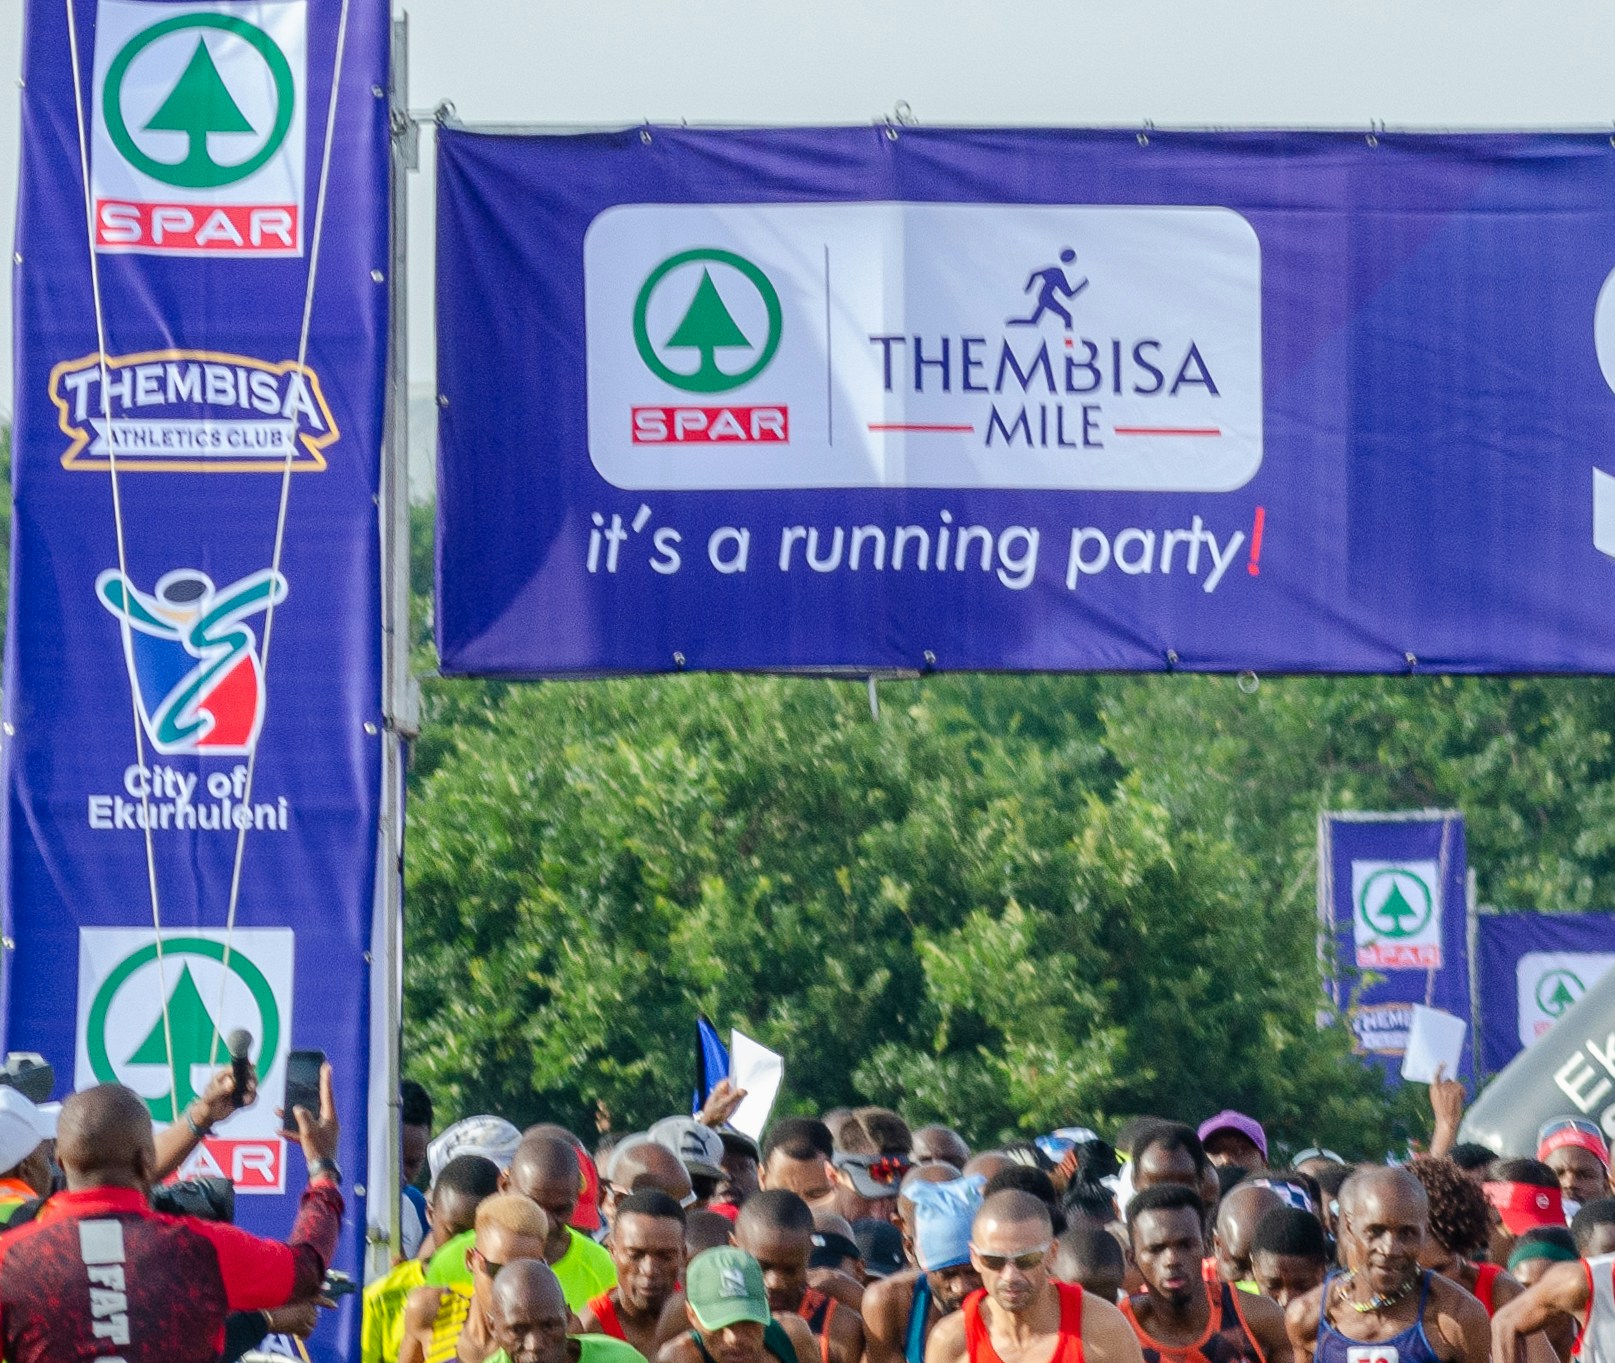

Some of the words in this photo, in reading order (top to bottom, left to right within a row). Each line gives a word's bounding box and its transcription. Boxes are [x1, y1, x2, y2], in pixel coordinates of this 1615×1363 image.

[97, 204, 295, 248] SPAR
[869, 336, 1221, 397] THEMBISA
[64, 362, 324, 430] THEMBISA
[105, 428, 221, 449] ATHLETICS
[226, 428, 284, 448] CLUB
[635, 408, 785, 442] SPAR
[985, 404, 1104, 449] MILE
[587, 503, 682, 574] it's
[707, 525, 750, 574] a
[779, 509, 1041, 589] running
[1066, 506, 1266, 593] party!
[124, 766, 201, 804] City
[205, 763, 253, 797] of
[88, 795, 289, 832] Ekurhuleni
[178, 1143, 280, 1184] AR
[86, 1264, 131, 1347] FAT
